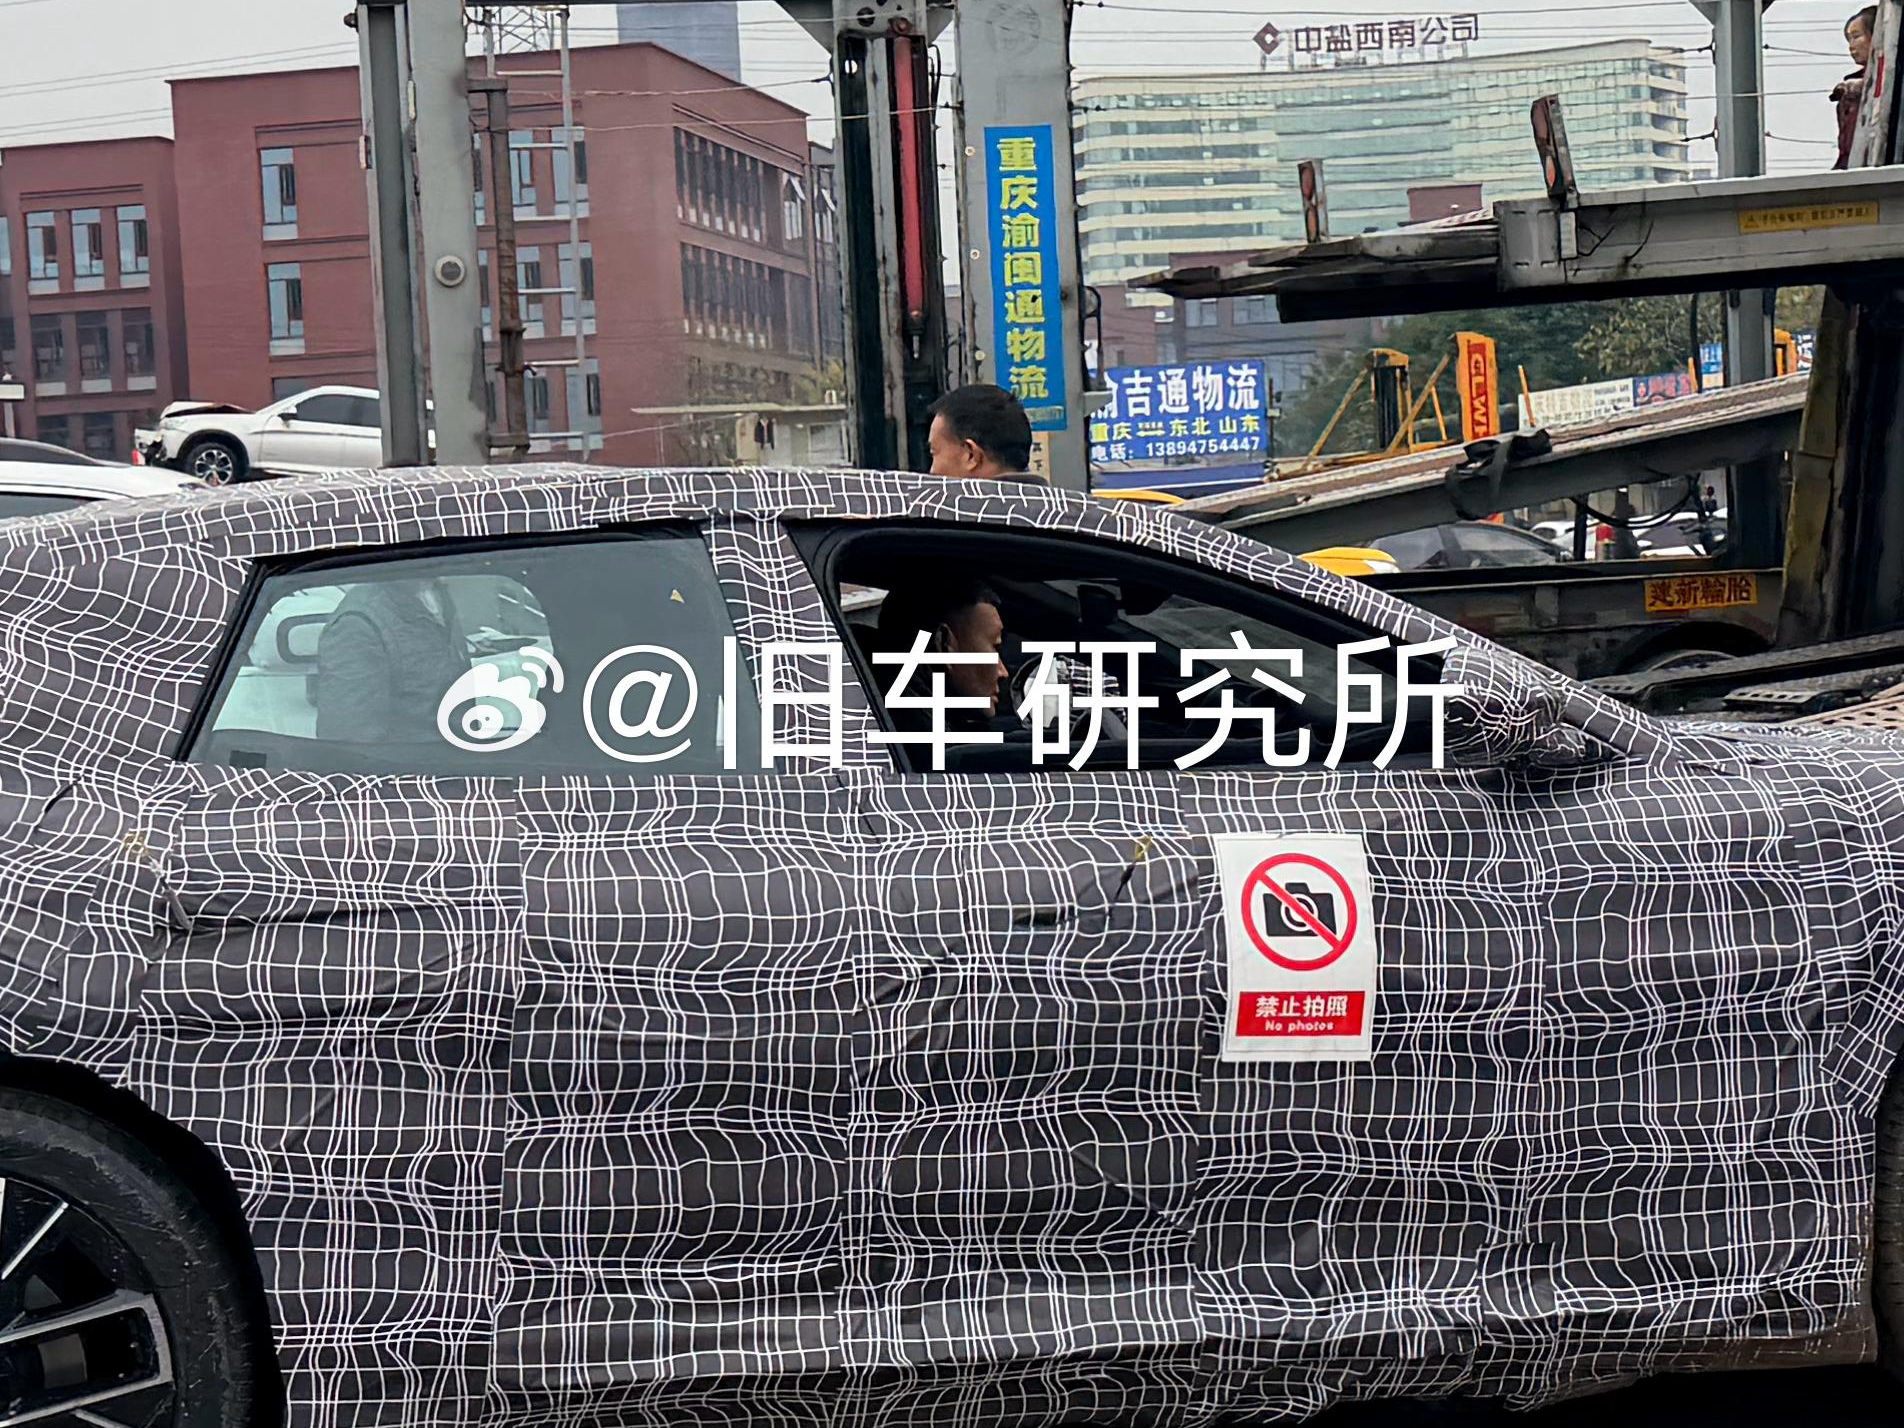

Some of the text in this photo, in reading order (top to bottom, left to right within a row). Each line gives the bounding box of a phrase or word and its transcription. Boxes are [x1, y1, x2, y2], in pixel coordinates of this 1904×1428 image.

[1294, 13, 1479, 53] 中盐西南公司
[1091, 413, 1260, 443] 重庆 东北 山东
[1146, 436, 1260, 457] 13894754447
[1255, 995, 1348, 1018] 禁止拍照
[1264, 1020, 1335, 1033] No photos
